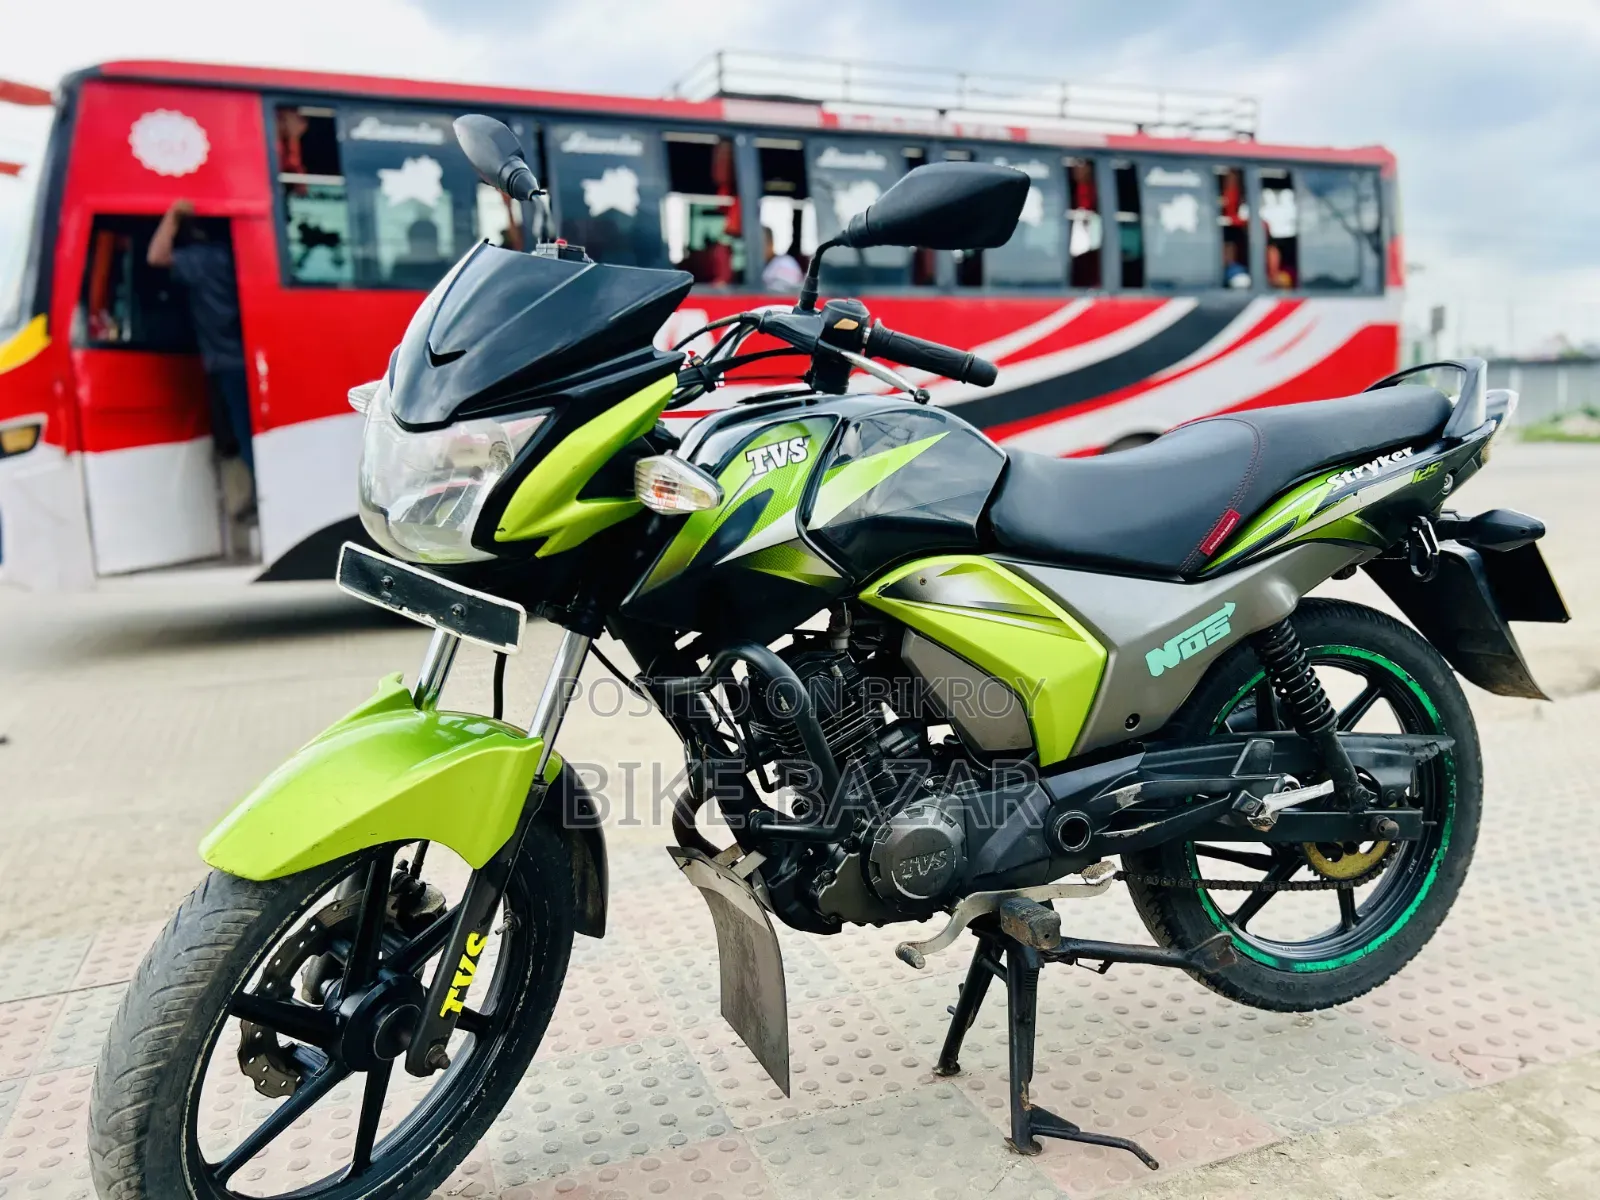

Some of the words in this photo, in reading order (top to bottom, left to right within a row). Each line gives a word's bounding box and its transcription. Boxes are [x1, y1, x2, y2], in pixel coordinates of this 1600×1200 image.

[745, 436, 809, 476] TVS
[1326, 446, 1413, 491] Stryker
[1411, 460, 1443, 484] 125
[899, 849, 948, 880] TVS
[439, 931, 489, 1018] TVS
